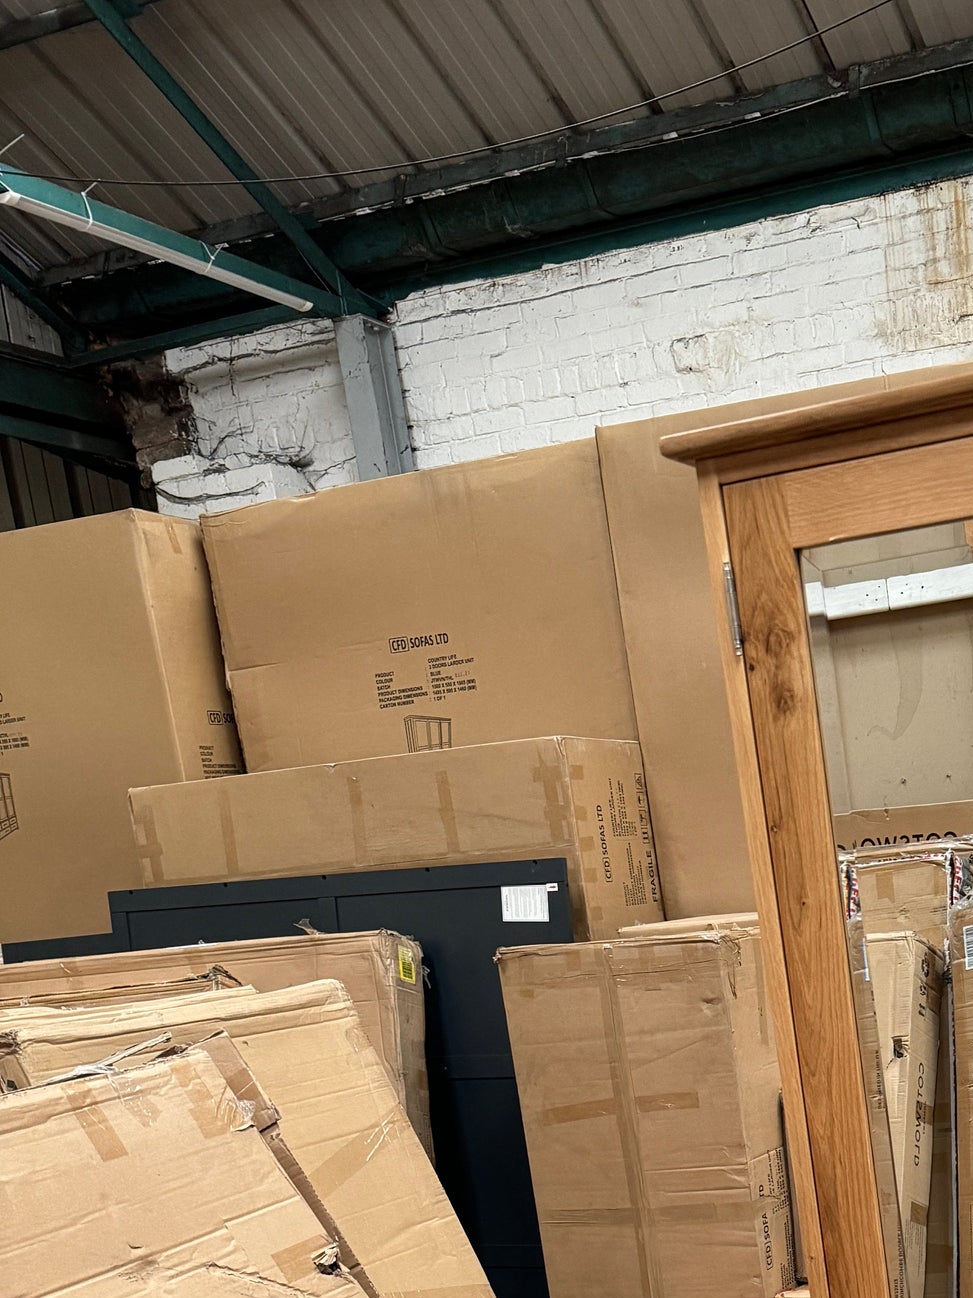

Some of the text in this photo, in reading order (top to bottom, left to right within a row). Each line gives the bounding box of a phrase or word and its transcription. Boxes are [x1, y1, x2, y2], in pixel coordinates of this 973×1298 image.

[391, 633, 449, 651] CFD SOFAS LTD
[427, 656, 448, 664] COUNTRY
[223, 712, 235, 724] SO
[599, 823, 609, 855] SOFAS
[604, 860, 612, 879] CFD
[645, 850, 659, 903] FRAGILE
